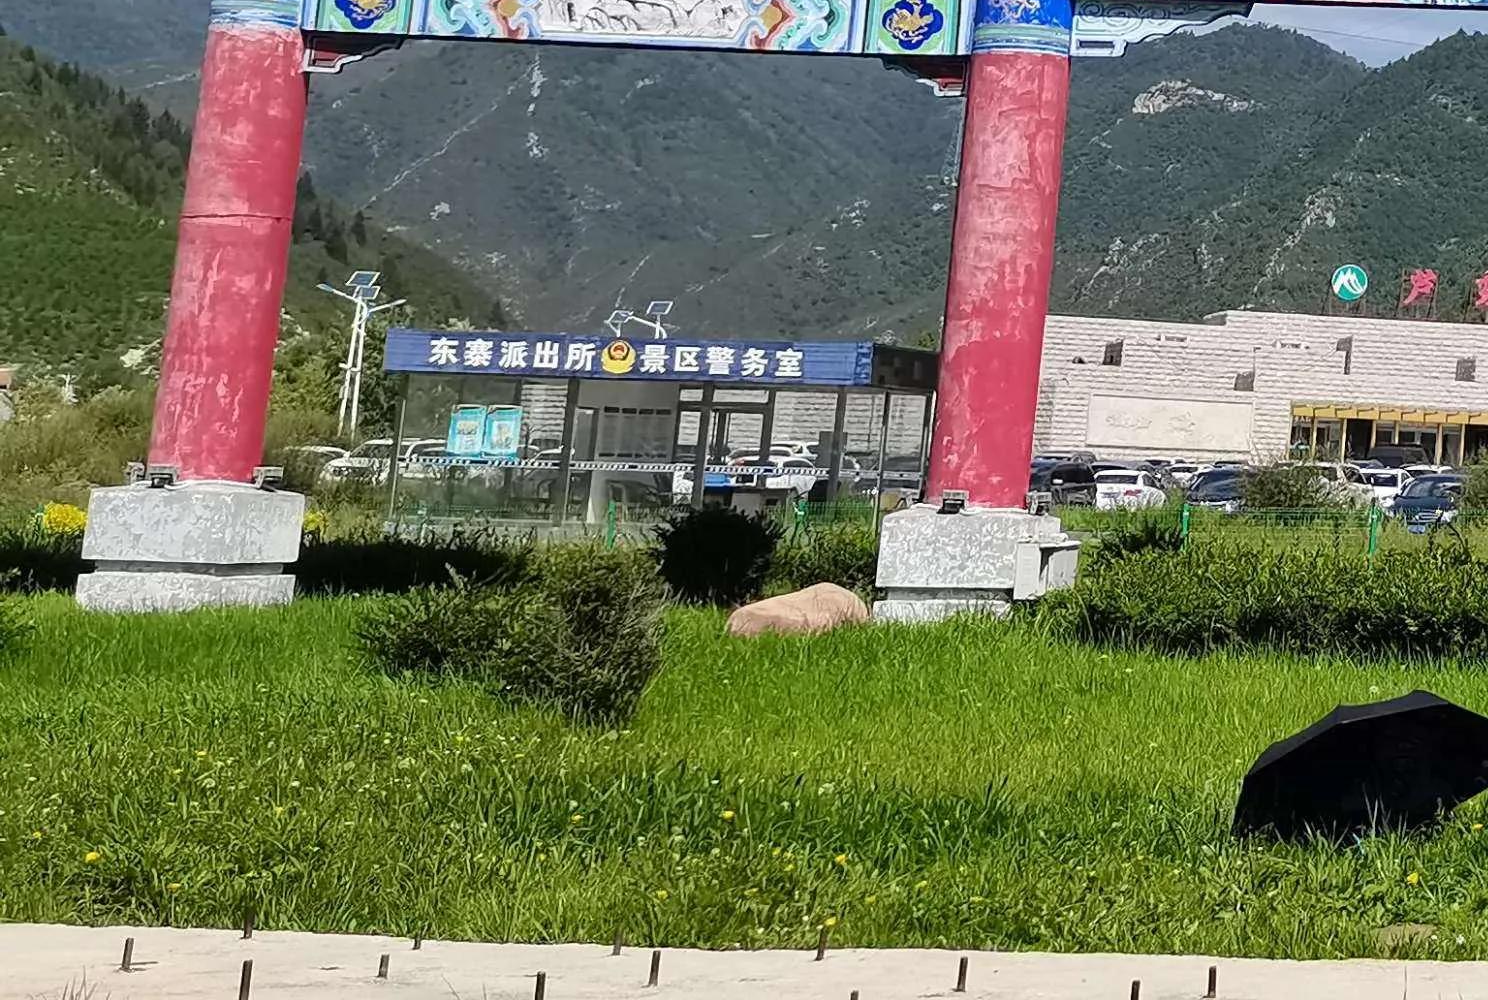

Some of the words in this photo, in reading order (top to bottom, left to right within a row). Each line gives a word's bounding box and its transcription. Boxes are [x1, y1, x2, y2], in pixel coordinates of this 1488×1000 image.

[428, 337, 596, 373] 东寨派出所
[638, 343, 804, 378] 景区警务室
